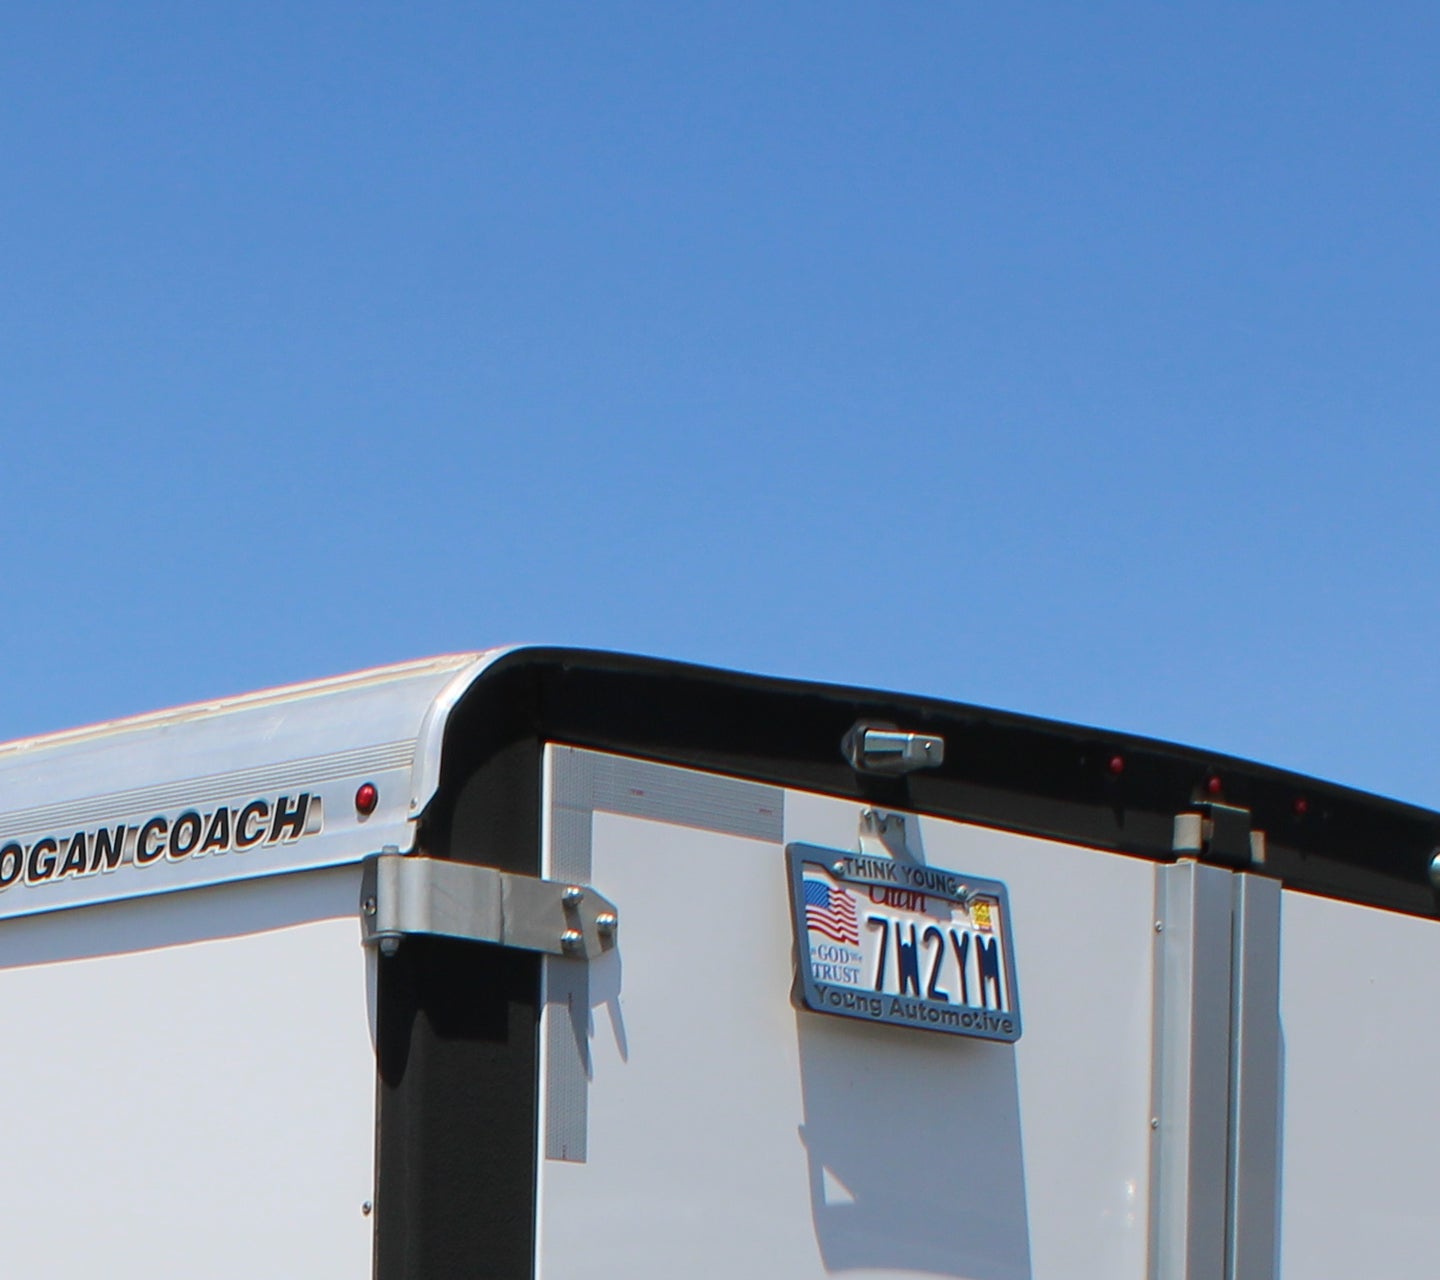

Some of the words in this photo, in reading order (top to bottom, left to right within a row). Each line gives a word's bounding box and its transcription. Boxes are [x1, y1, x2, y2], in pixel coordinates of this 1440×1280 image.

[135, 792, 312, 866] COACH
[843, 856, 897, 881] THINK
[901, 865, 958, 895] YOUNG
[812, 962, 860, 985] TRUST
[817, 944, 850, 964] GOD
[867, 915, 1002, 1011] 7W2YM
[814, 984, 883, 1017] Young
[889, 998, 1014, 1034] Automotive
